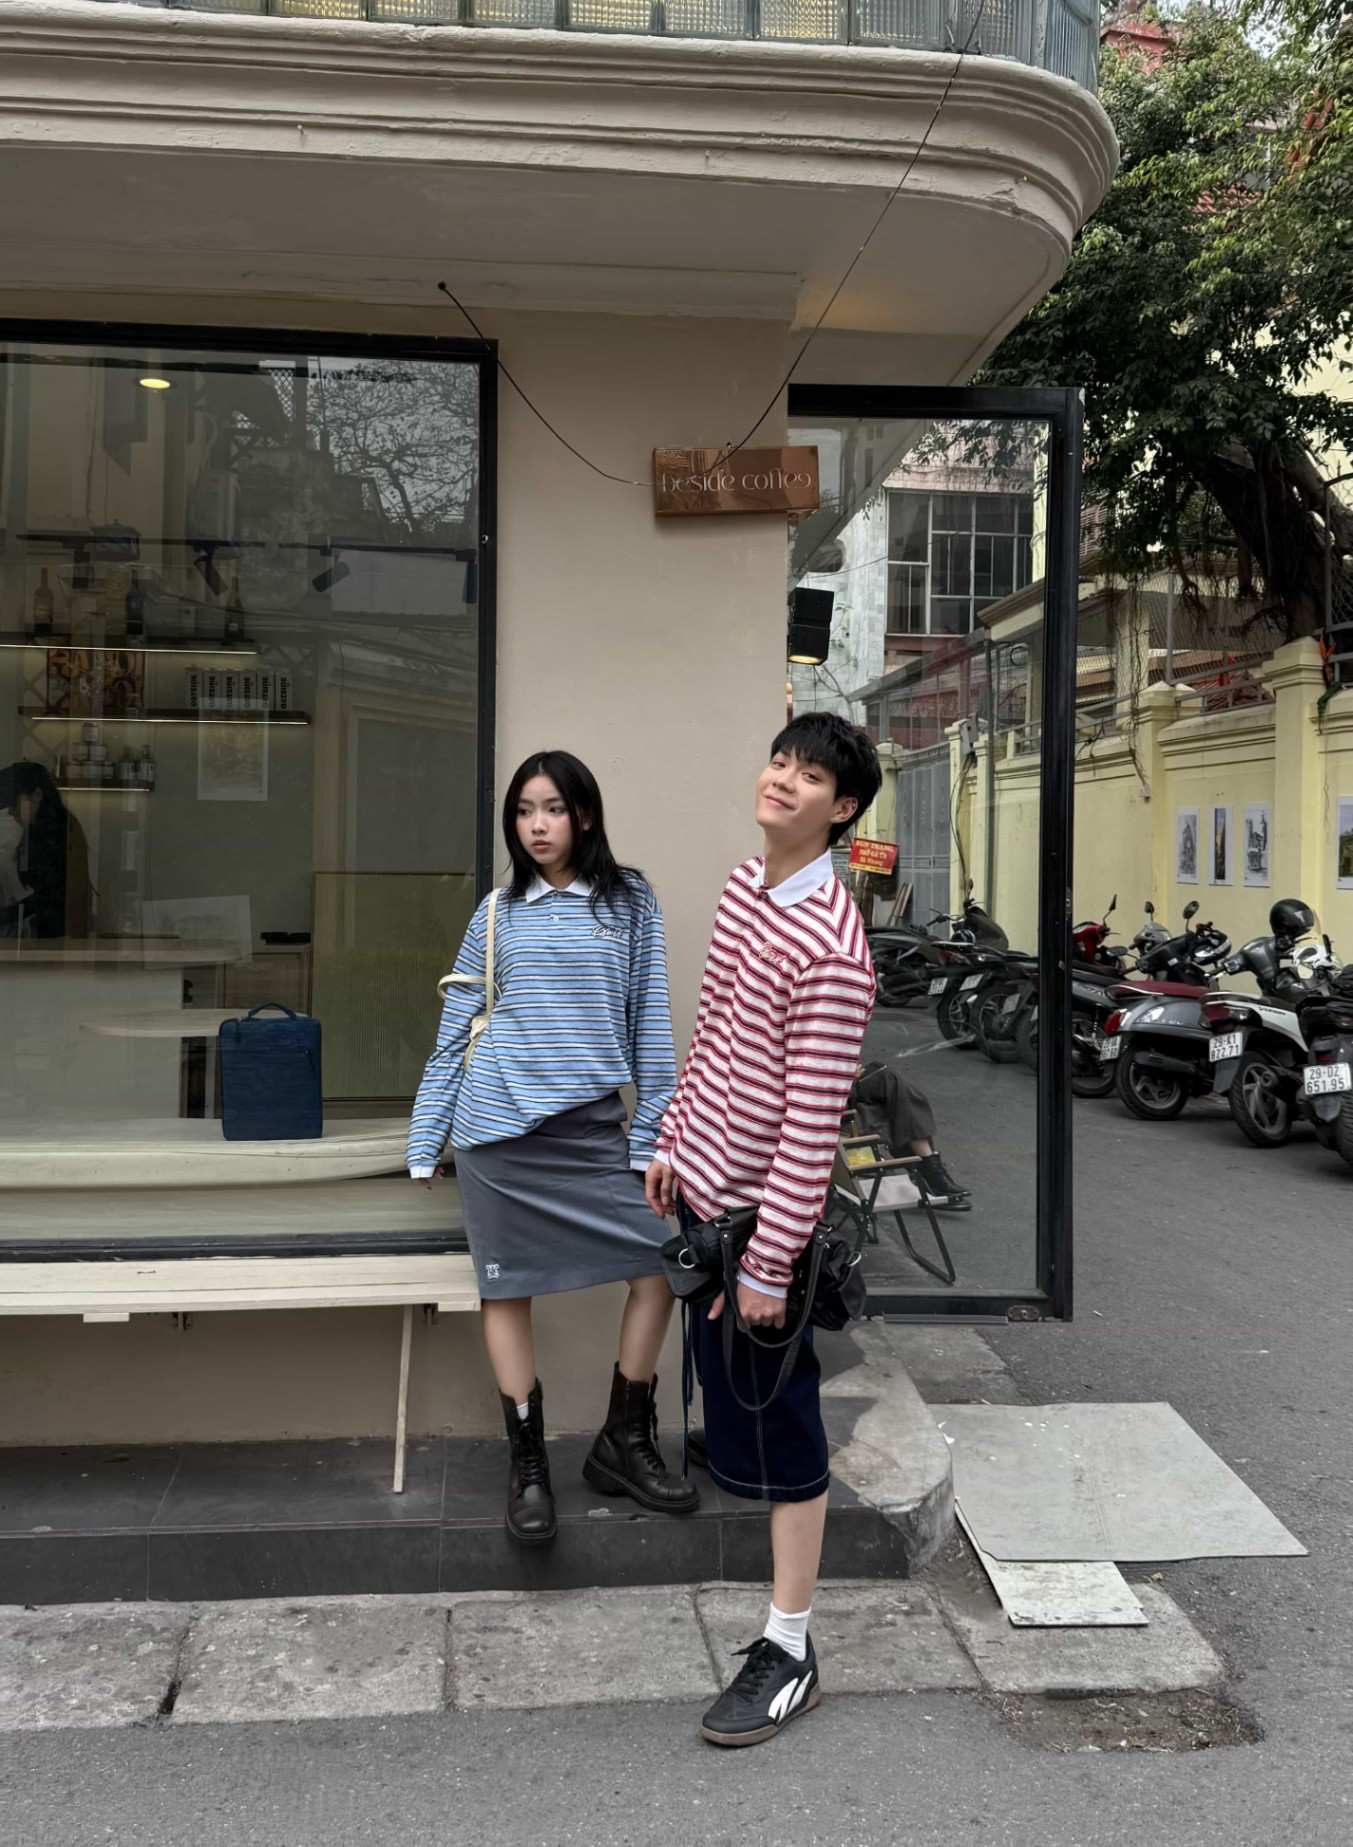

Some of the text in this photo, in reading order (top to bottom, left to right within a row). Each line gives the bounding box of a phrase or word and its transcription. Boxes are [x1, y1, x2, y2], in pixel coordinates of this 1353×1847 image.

[662, 468, 811, 492] beside coffee
[1213, 1034, 1236, 1048] 29-K1
[1309, 1066, 1339, 1080] 29-D2
[1307, 1077, 1345, 1093] 651.95
